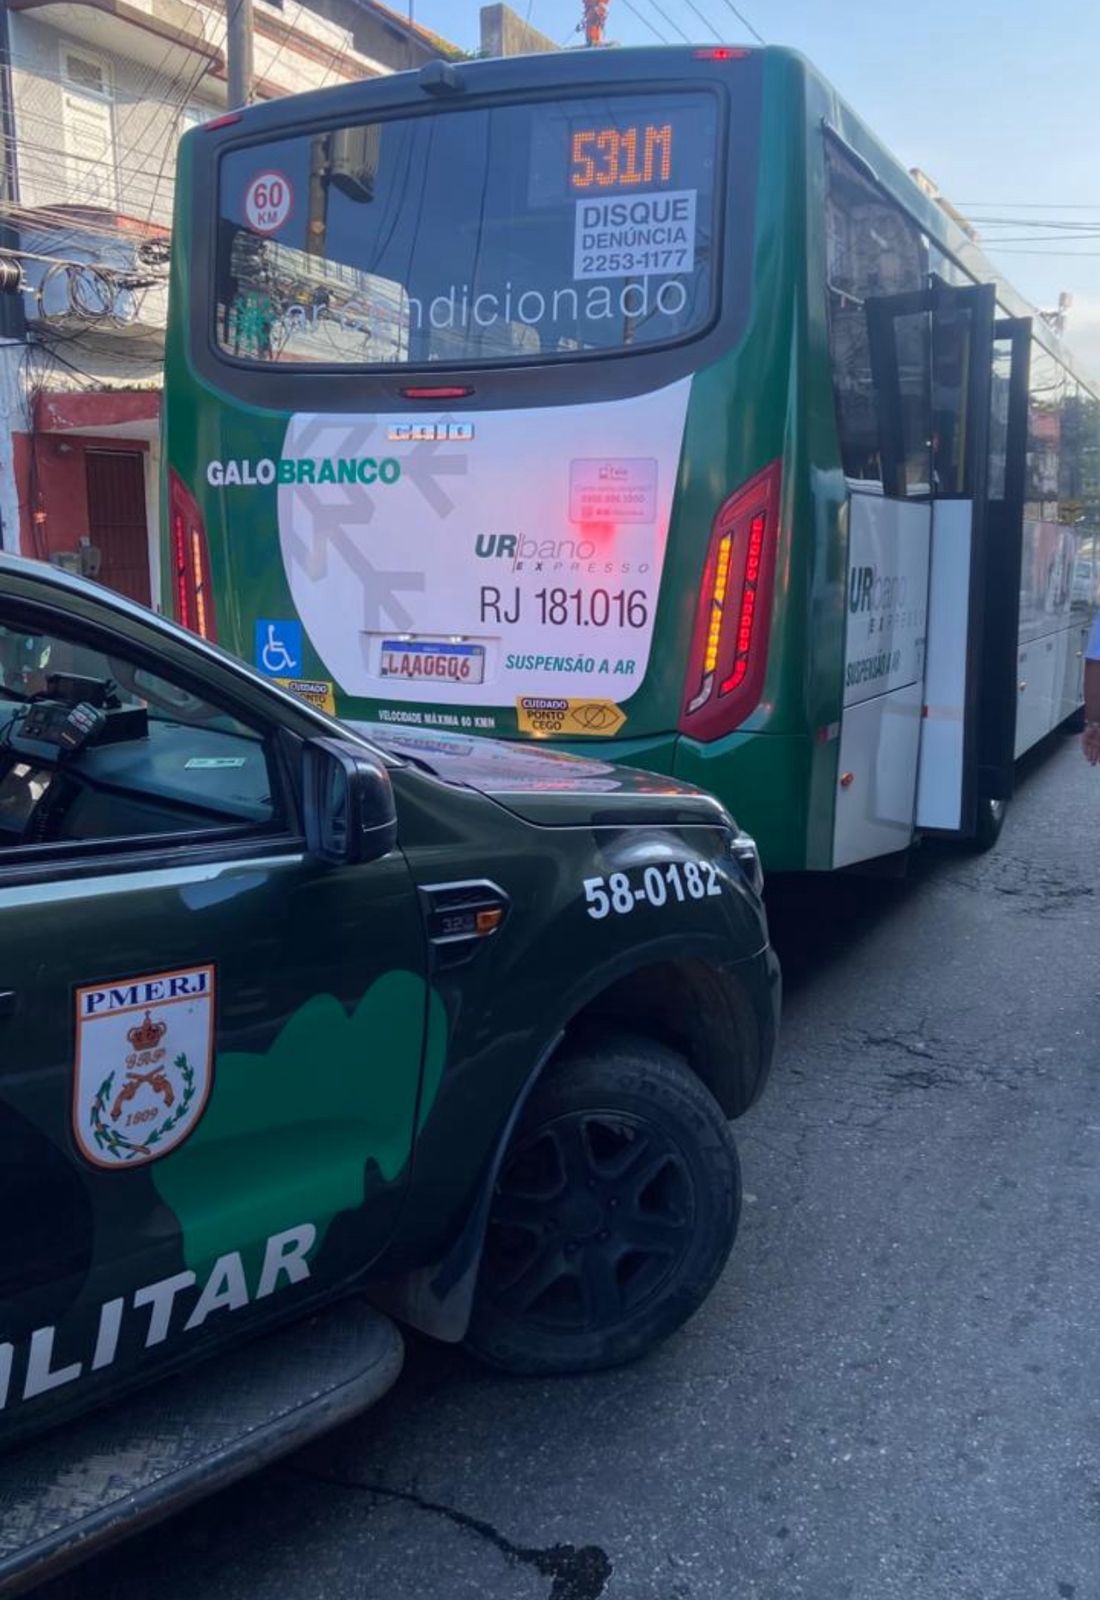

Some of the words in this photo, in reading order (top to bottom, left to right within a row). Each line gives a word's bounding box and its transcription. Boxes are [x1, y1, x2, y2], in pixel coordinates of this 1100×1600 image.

[573, 125, 672, 186] 531M
[254, 181, 282, 209] 60
[257, 211, 278, 226] KM
[583, 199, 689, 229] DISQUE
[582, 227, 687, 250] DENÚNCIA
[582, 250, 687, 273] 2253-1177
[341, 276, 687, 332] cndicionado
[516, 562, 648, 574] EXPRESSO
[481, 586, 520, 624] RJ
[535, 588, 648, 628] 181.016
[505, 653, 594, 673] SUSPENSÃO
[599, 661, 609, 674] A
[613, 661, 635, 675] AR
[522, 698, 567, 709] CUIDADO
[527, 711, 565, 721] PONTO
[532, 721, 561, 730] CEGO
[584, 860, 722, 920] 58-0182
[85, 972, 207, 1014] PMERJ
[125, 1107, 159, 1126] 1809
